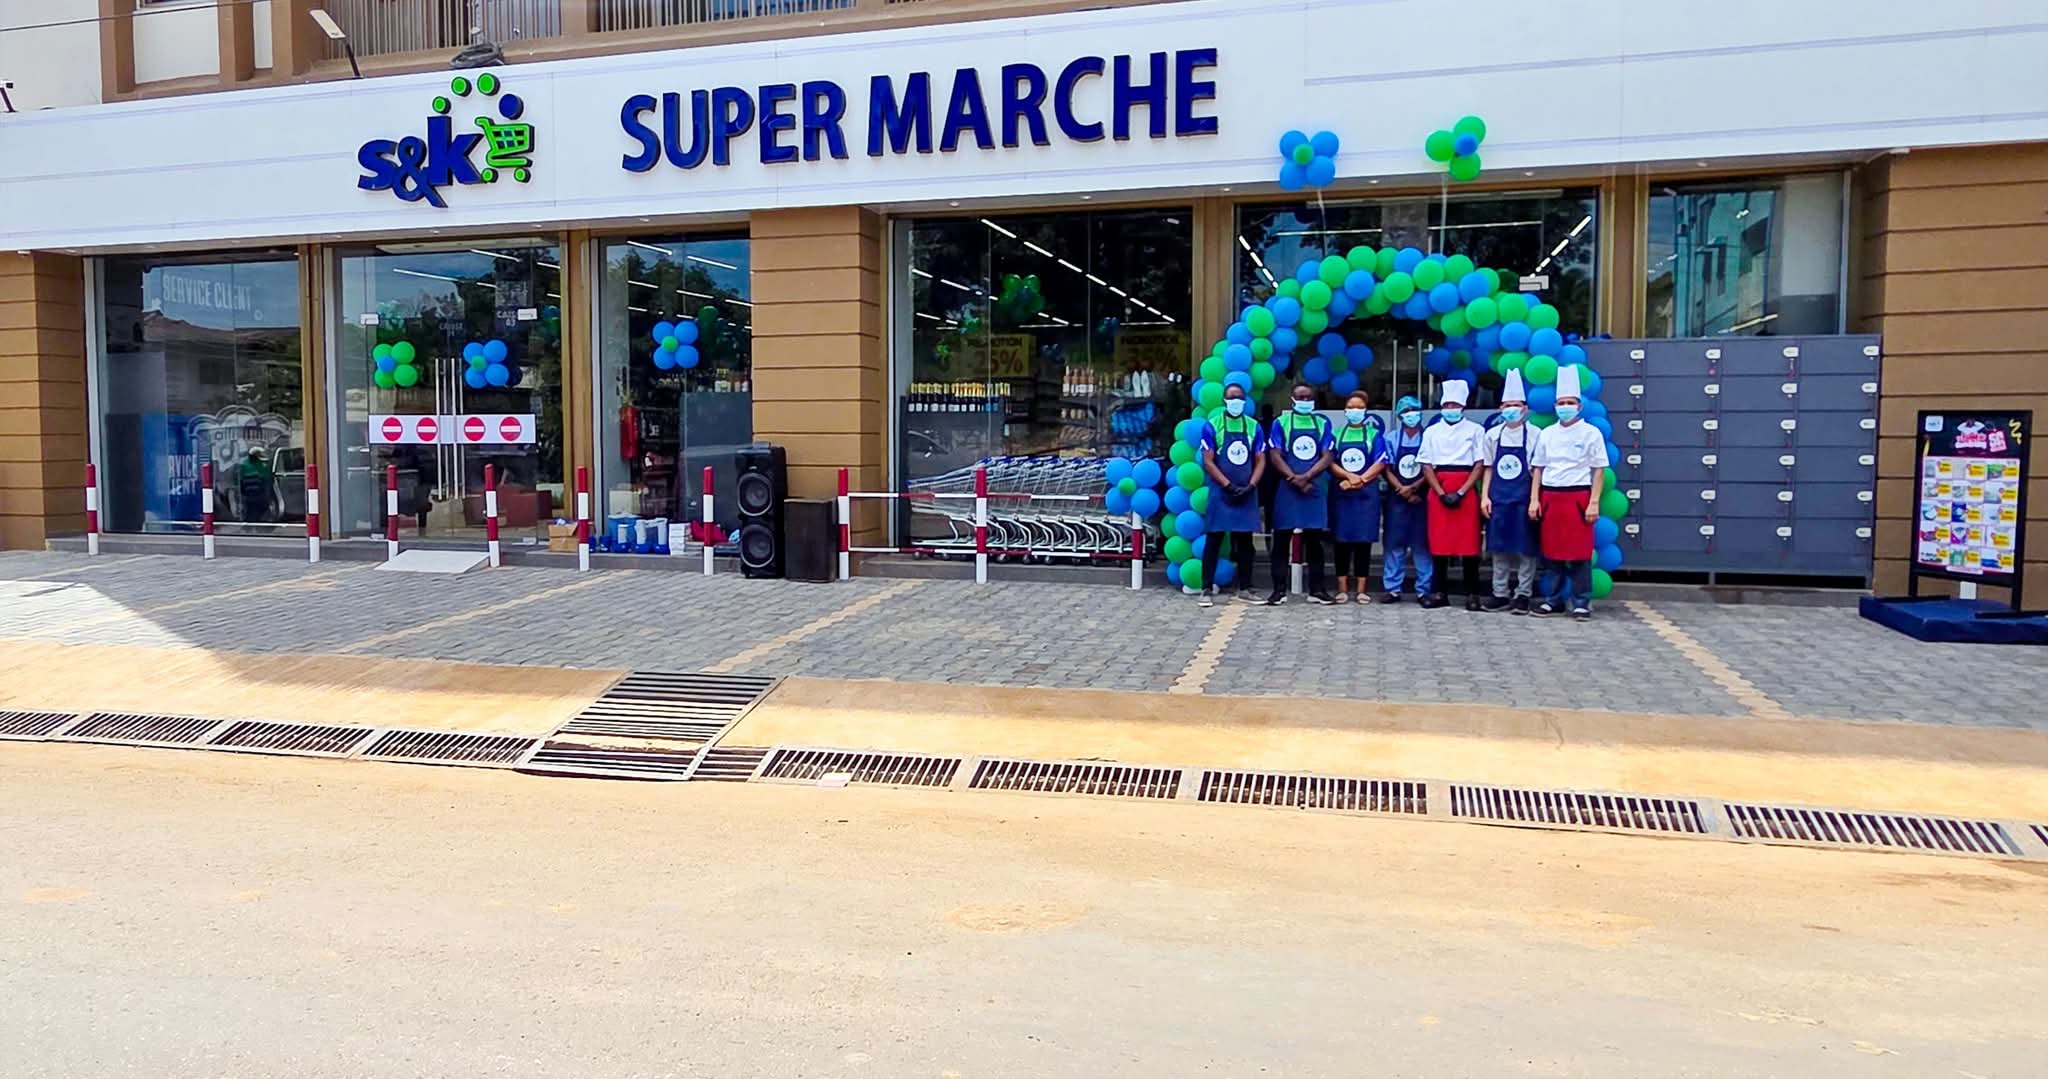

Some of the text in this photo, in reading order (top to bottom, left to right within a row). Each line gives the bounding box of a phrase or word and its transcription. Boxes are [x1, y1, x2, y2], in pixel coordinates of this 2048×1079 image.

[620, 47, 1218, 173] SUPER MARCHE
[163, 274, 251, 312] SERVICE CLIENT
